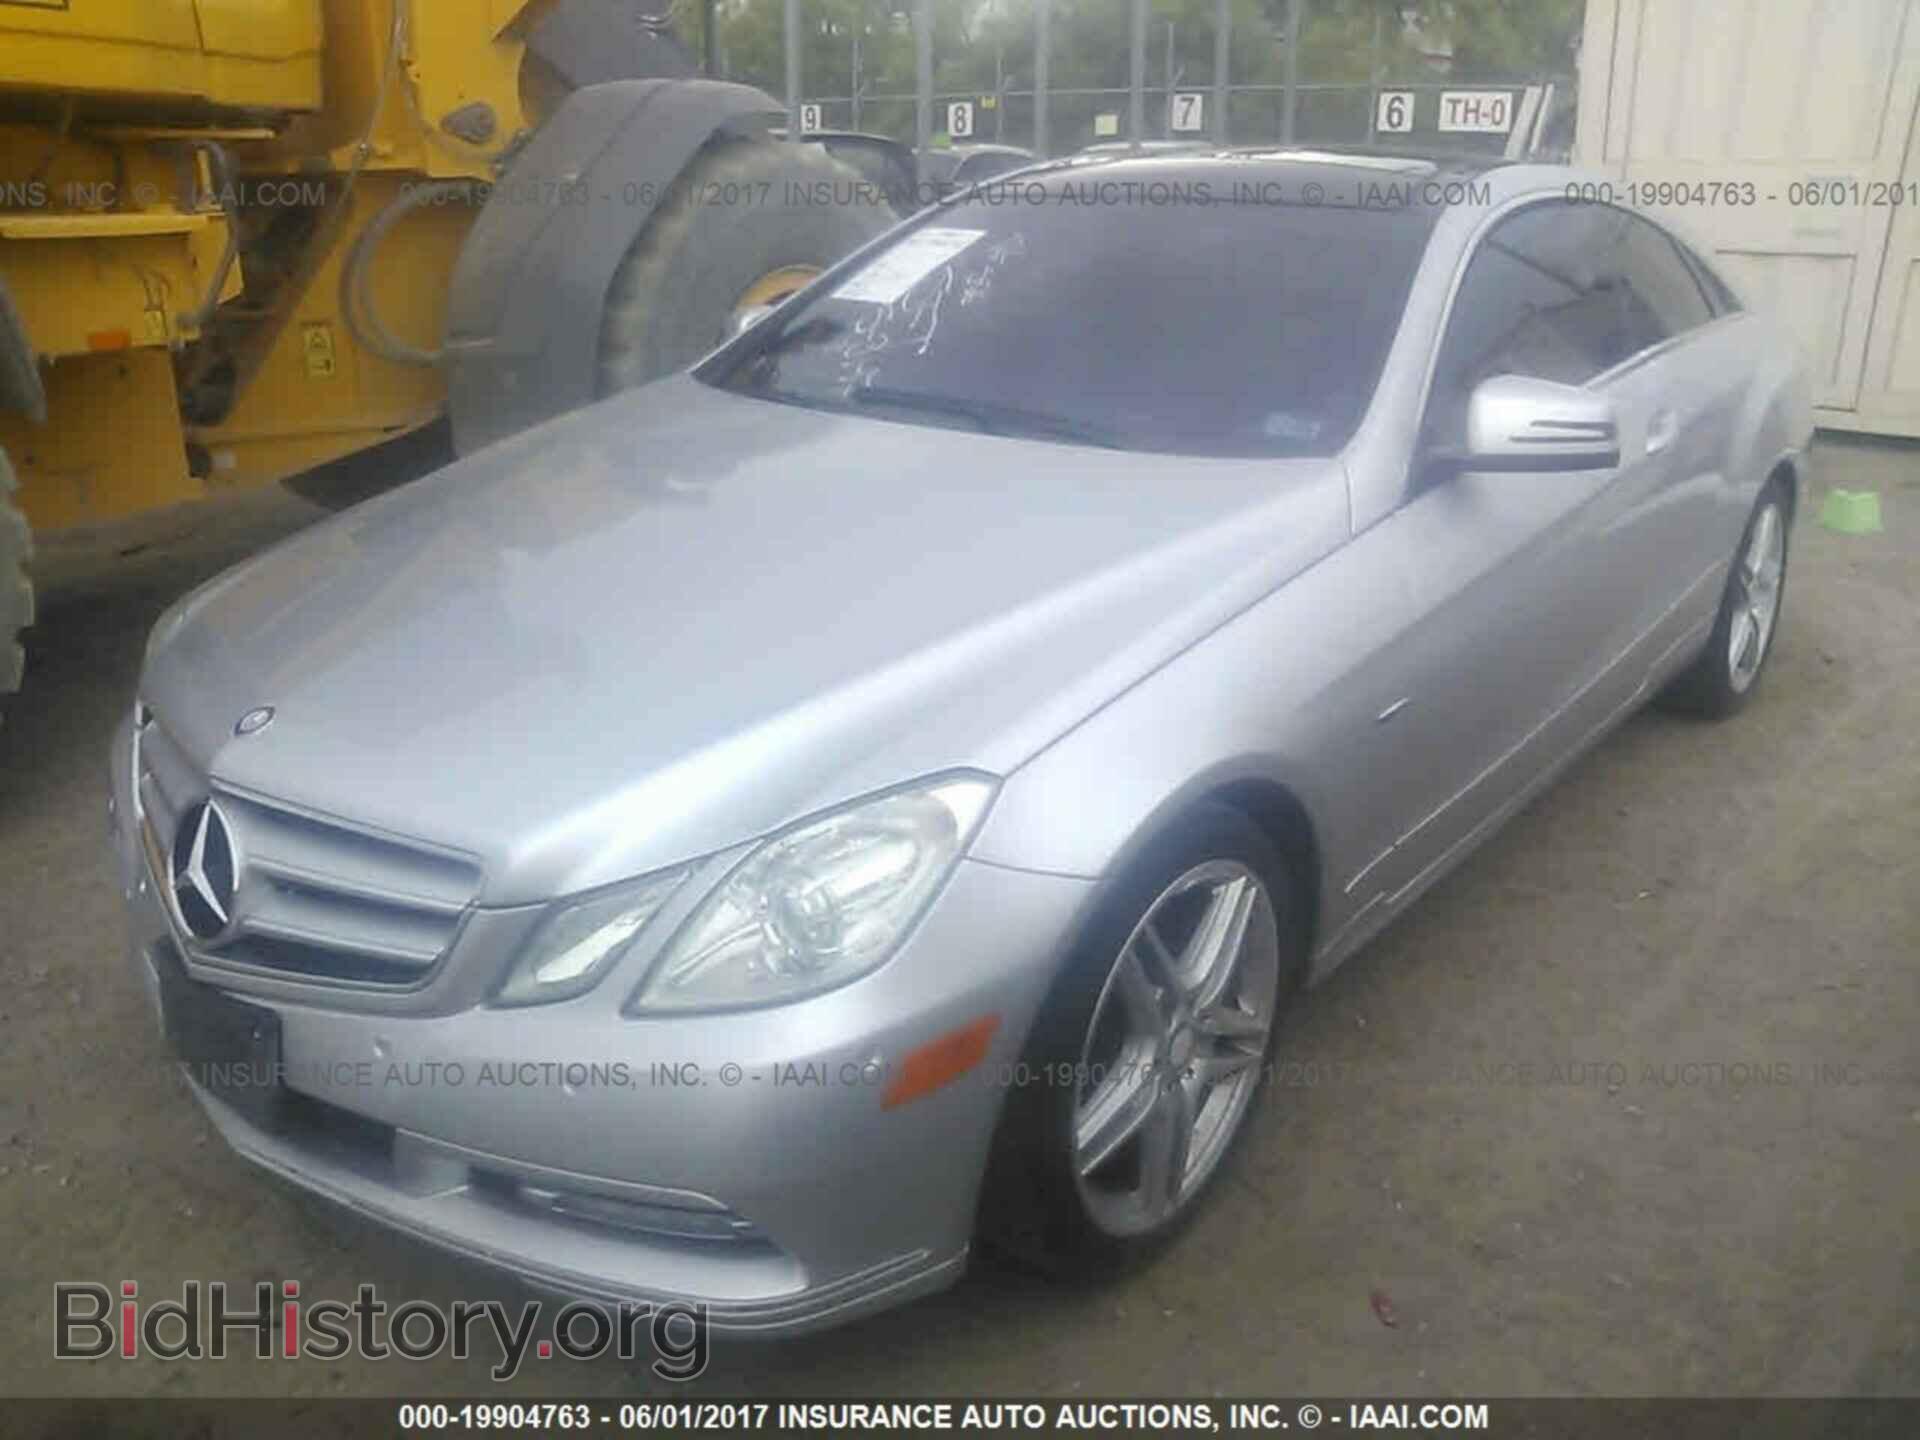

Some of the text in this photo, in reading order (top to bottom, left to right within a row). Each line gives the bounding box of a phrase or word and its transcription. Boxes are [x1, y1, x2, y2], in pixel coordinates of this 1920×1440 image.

[805, 107, 816, 131] 9
[954, 107, 967, 134] 8
[1179, 97, 1197, 125] 7
[1386, 95, 1404, 128] 6
